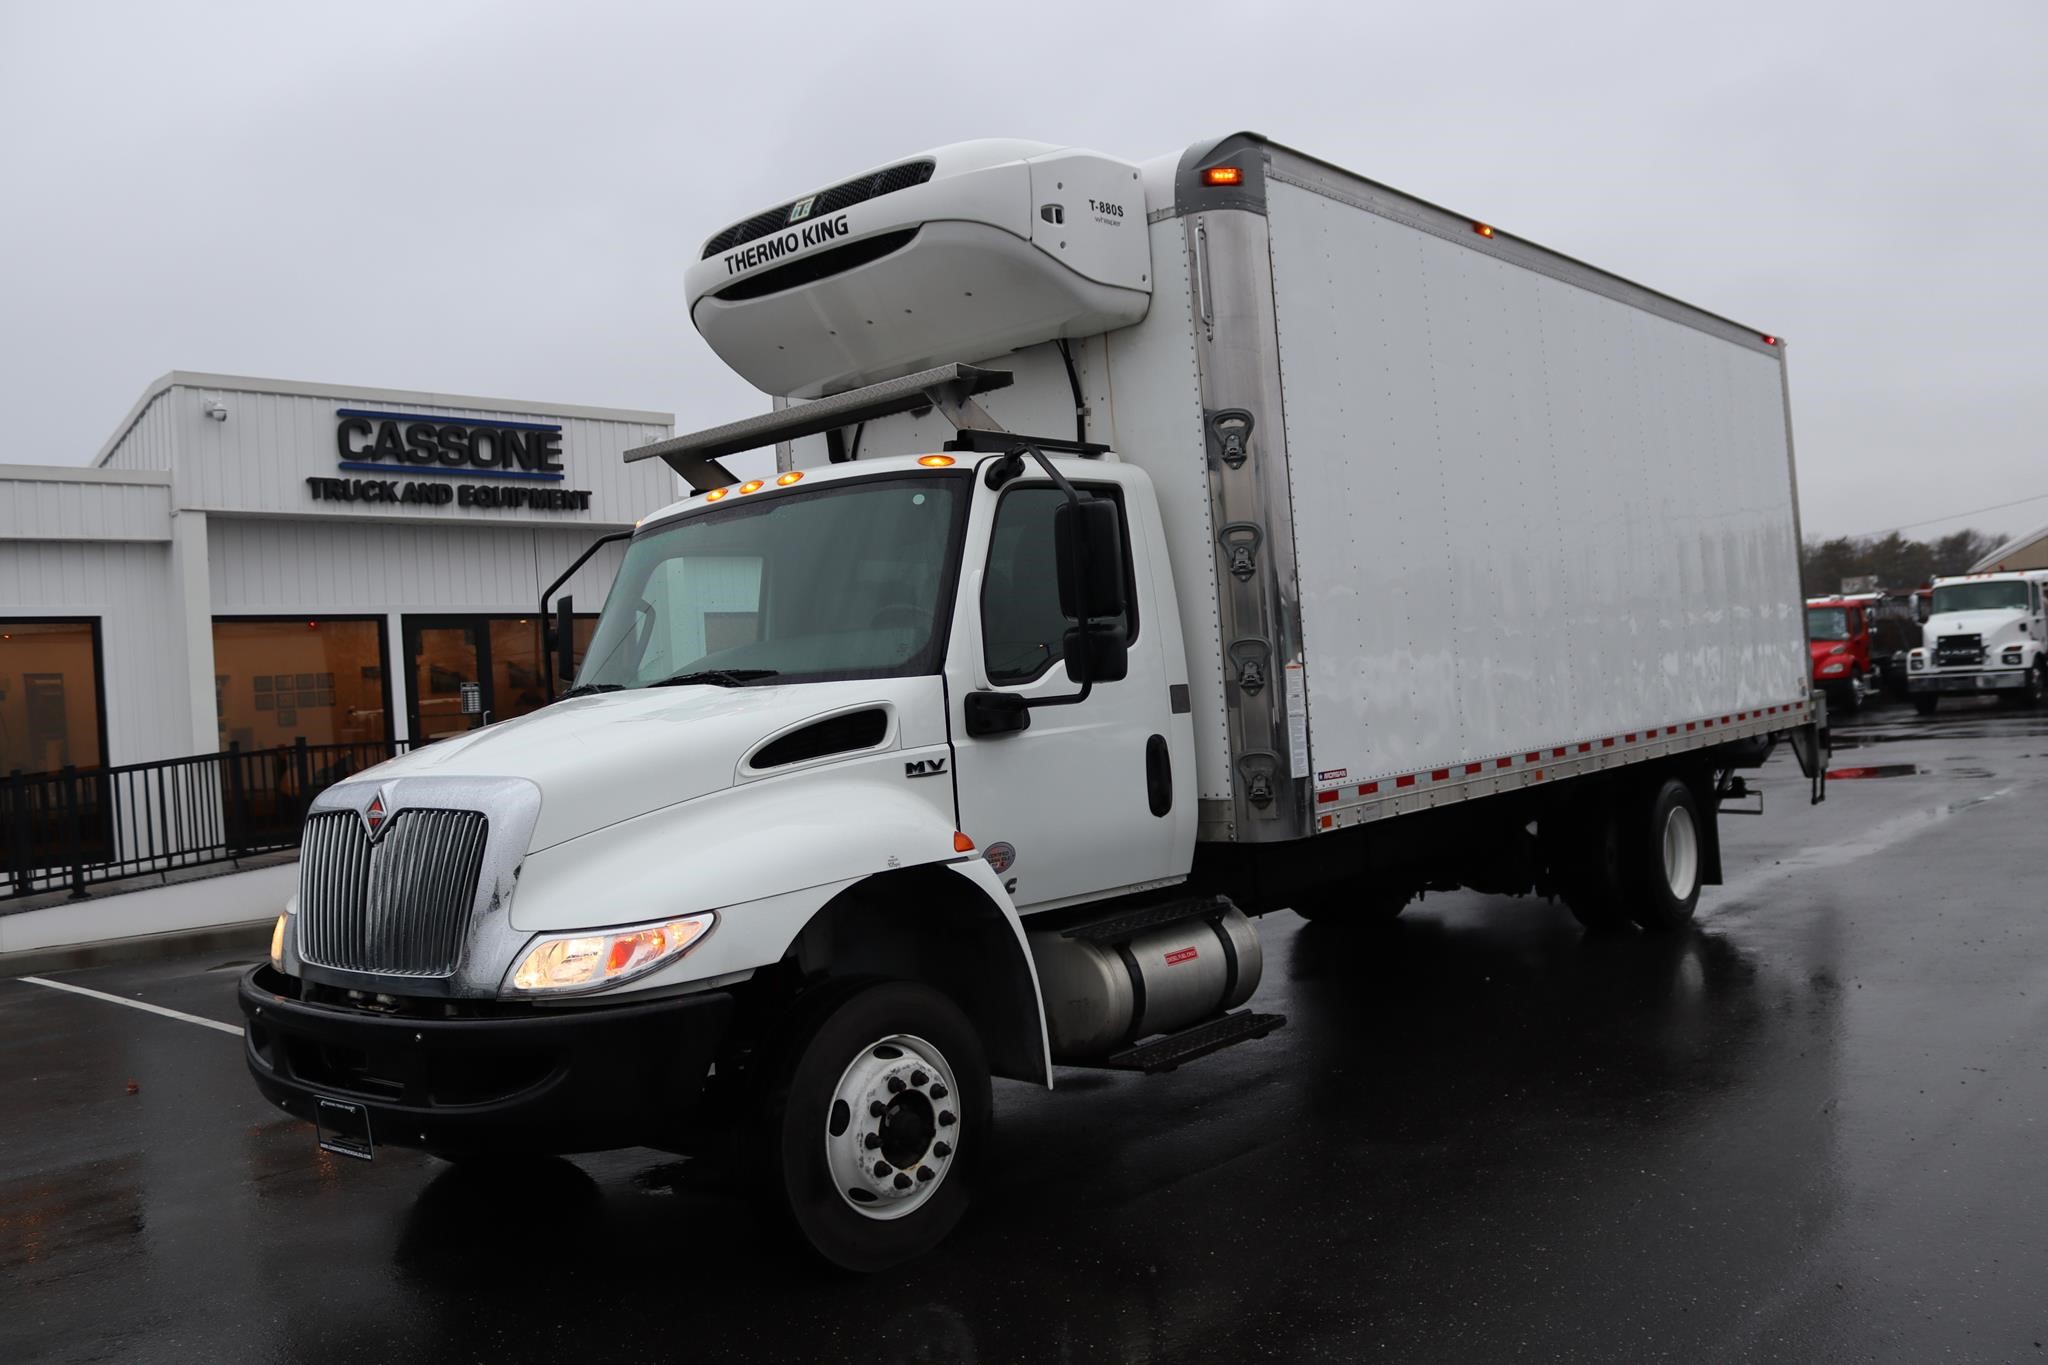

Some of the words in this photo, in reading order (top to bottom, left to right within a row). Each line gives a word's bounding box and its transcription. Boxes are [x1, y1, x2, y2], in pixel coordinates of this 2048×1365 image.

[724, 233, 799, 275] THERMO
[802, 214, 849, 248] KING
[337, 417, 564, 470] CASSONE
[306, 477, 400, 503] TRUCK
[400, 482, 453, 504] AND
[457, 484, 592, 510] EQUIPMENT
[904, 758, 946, 775] MV
